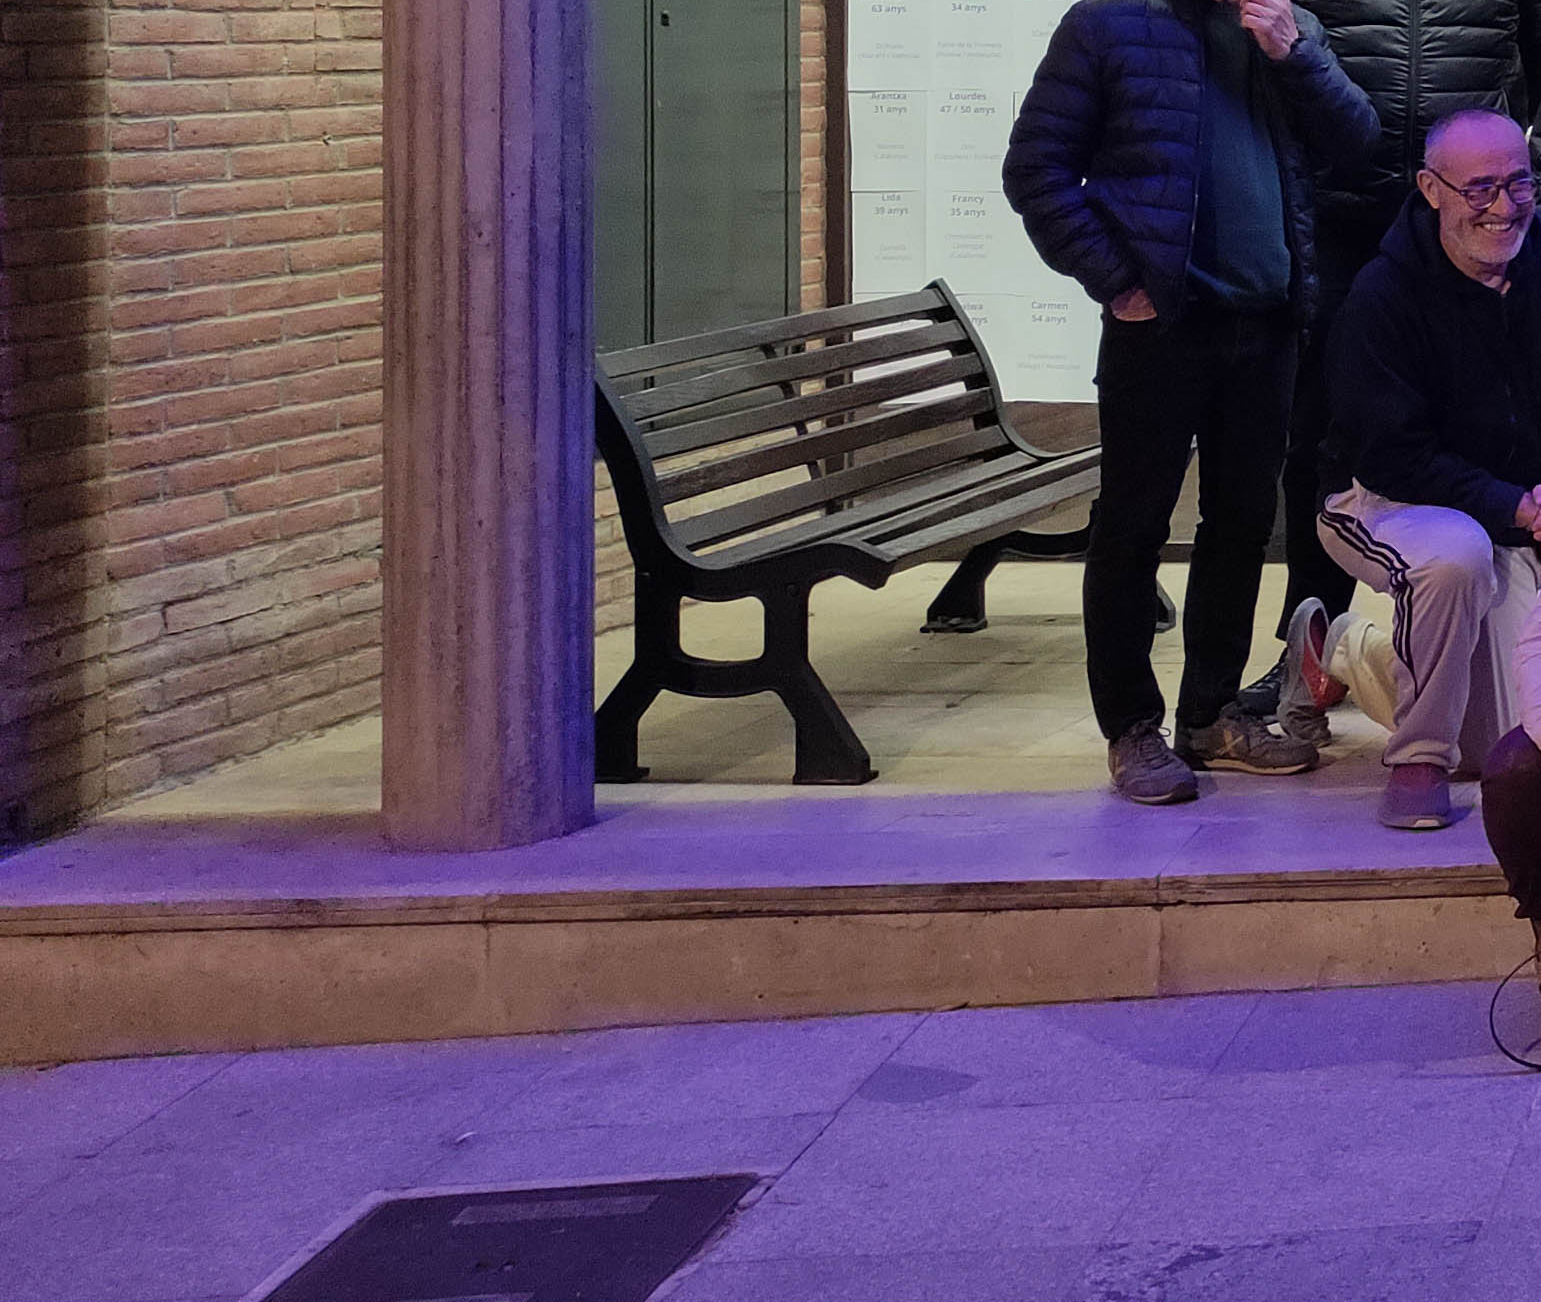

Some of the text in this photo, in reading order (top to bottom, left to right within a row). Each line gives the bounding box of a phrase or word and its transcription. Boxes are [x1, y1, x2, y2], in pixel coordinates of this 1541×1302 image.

[871, 4, 908, 16] 63 anys
[951, 2, 988, 14] 34 anys
[949, 91, 988, 101] Lourdes
[874, 105, 909, 116] 31 anys
[939, 104, 952, 115] 47
[960, 104, 973, 115] 50
[973, 105, 997, 116] anys
[952, 194, 985, 206] Francy
[873, 206, 910, 216] 39 anys
[951, 206, 988, 218] 35 anys
[1031, 300, 1069, 311] Carmen
[1031, 314, 1068, 326] 54 anys
